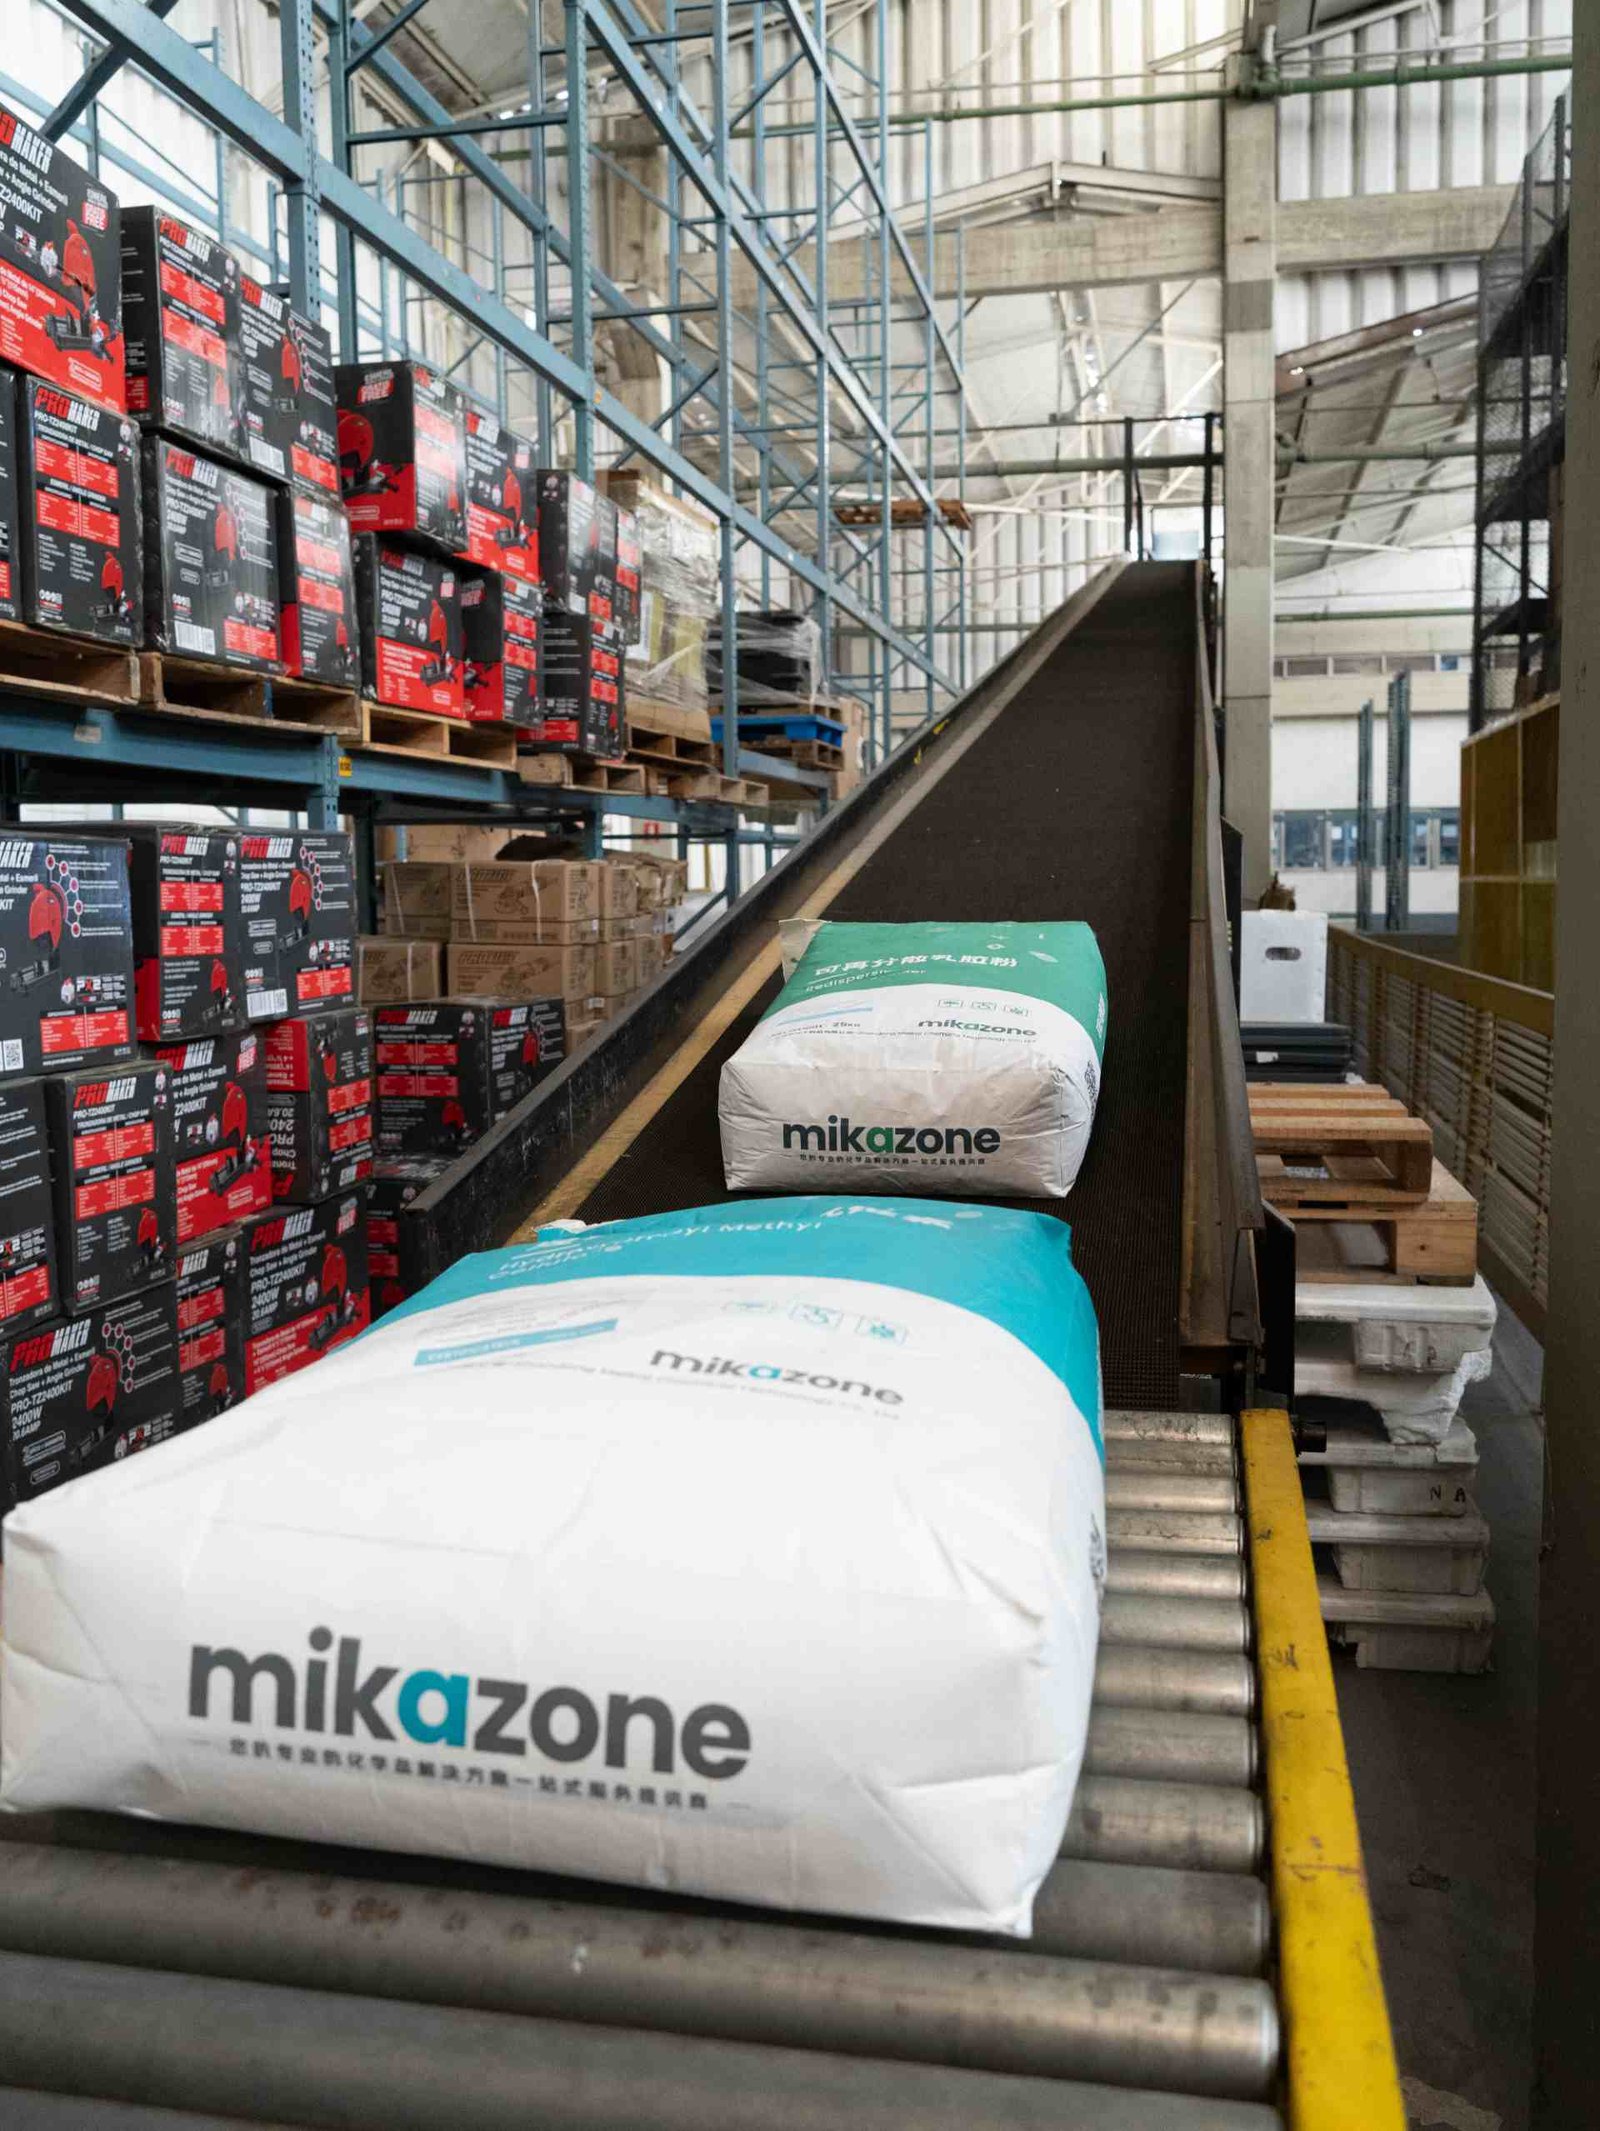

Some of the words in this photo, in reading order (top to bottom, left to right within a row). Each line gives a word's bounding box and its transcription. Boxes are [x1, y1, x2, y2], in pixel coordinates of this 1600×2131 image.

[35, 387, 100, 432] PROMAKER
[917, 1019, 1038, 1037] mikazone
[73, 1077, 137, 1110] PROMAKER
[783, 1115, 1001, 1154] mikazone
[9, 1319, 91, 1373] PROMAKER
[650, 1350, 904, 1406] mikazone
[12, 1405, 43, 1430] 2400W
[187, 1626, 751, 1780] mikazone
